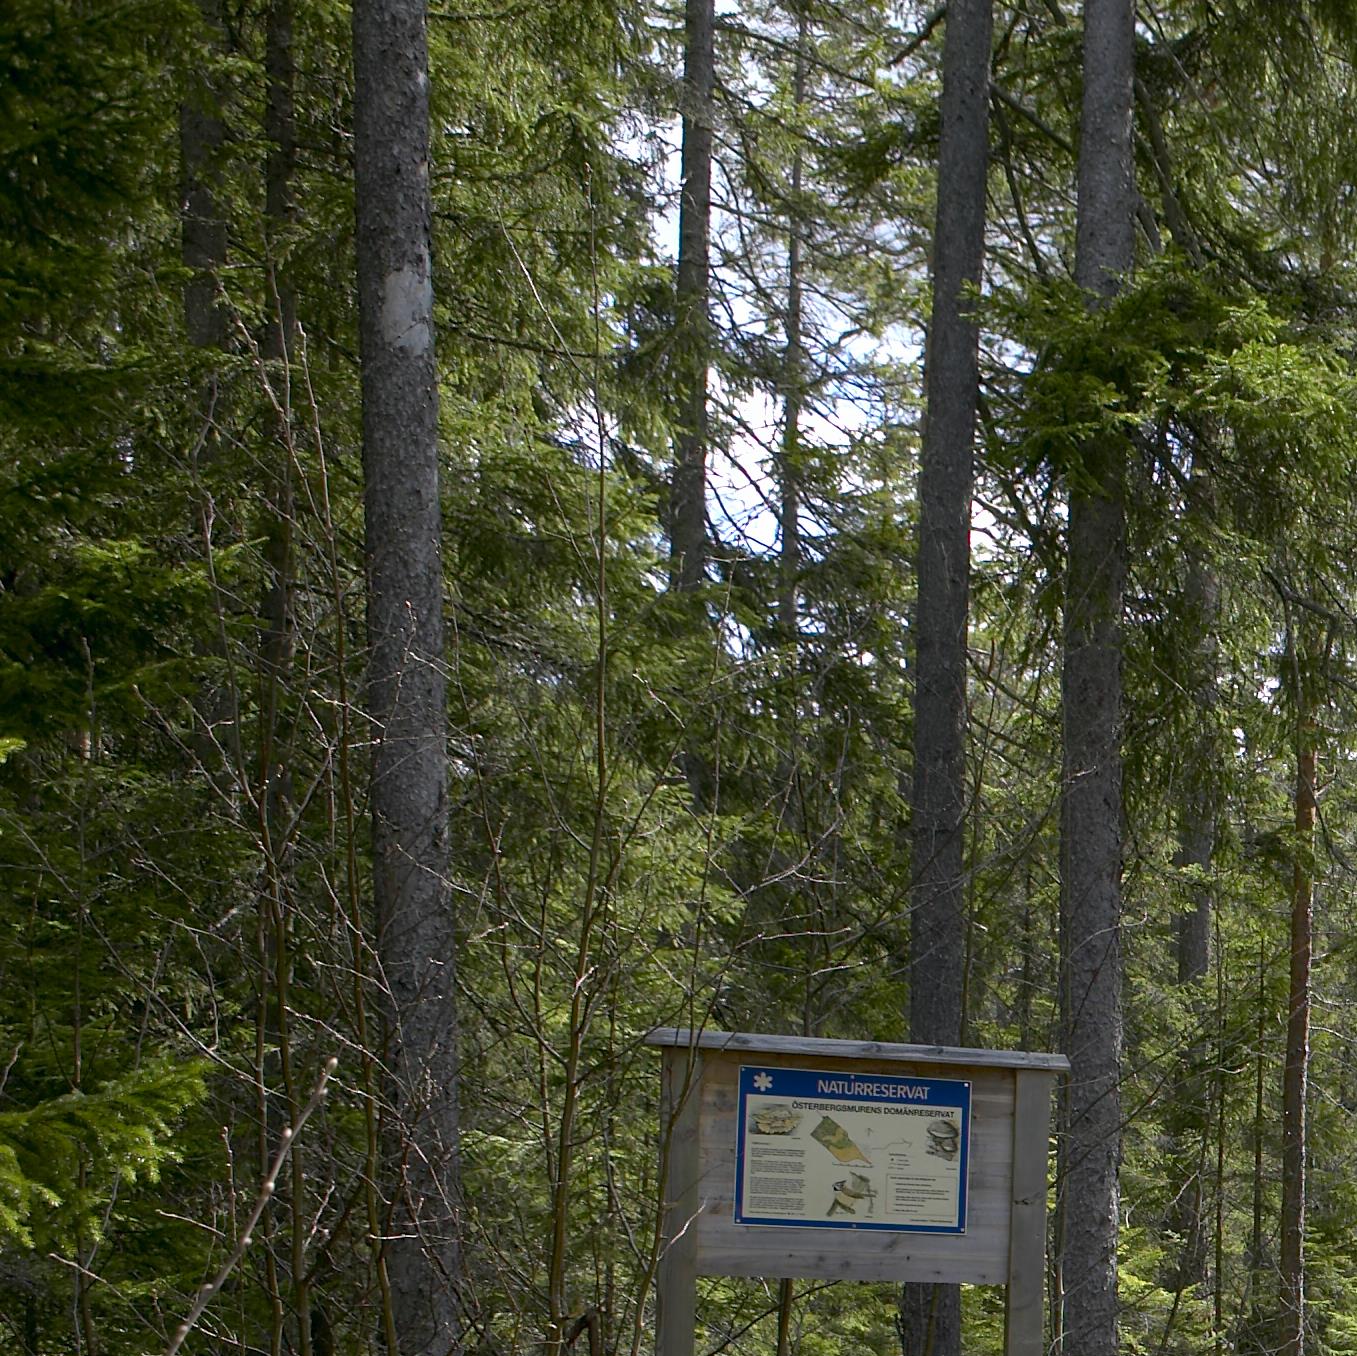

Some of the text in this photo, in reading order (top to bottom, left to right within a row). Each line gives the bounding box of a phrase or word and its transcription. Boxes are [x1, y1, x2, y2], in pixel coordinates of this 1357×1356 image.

[817, 1079, 931, 1100] NATURRESERVAT
[791, 1100, 955, 1118] ÖSTERBERGSMURENS DOMÄNRESERVAT
